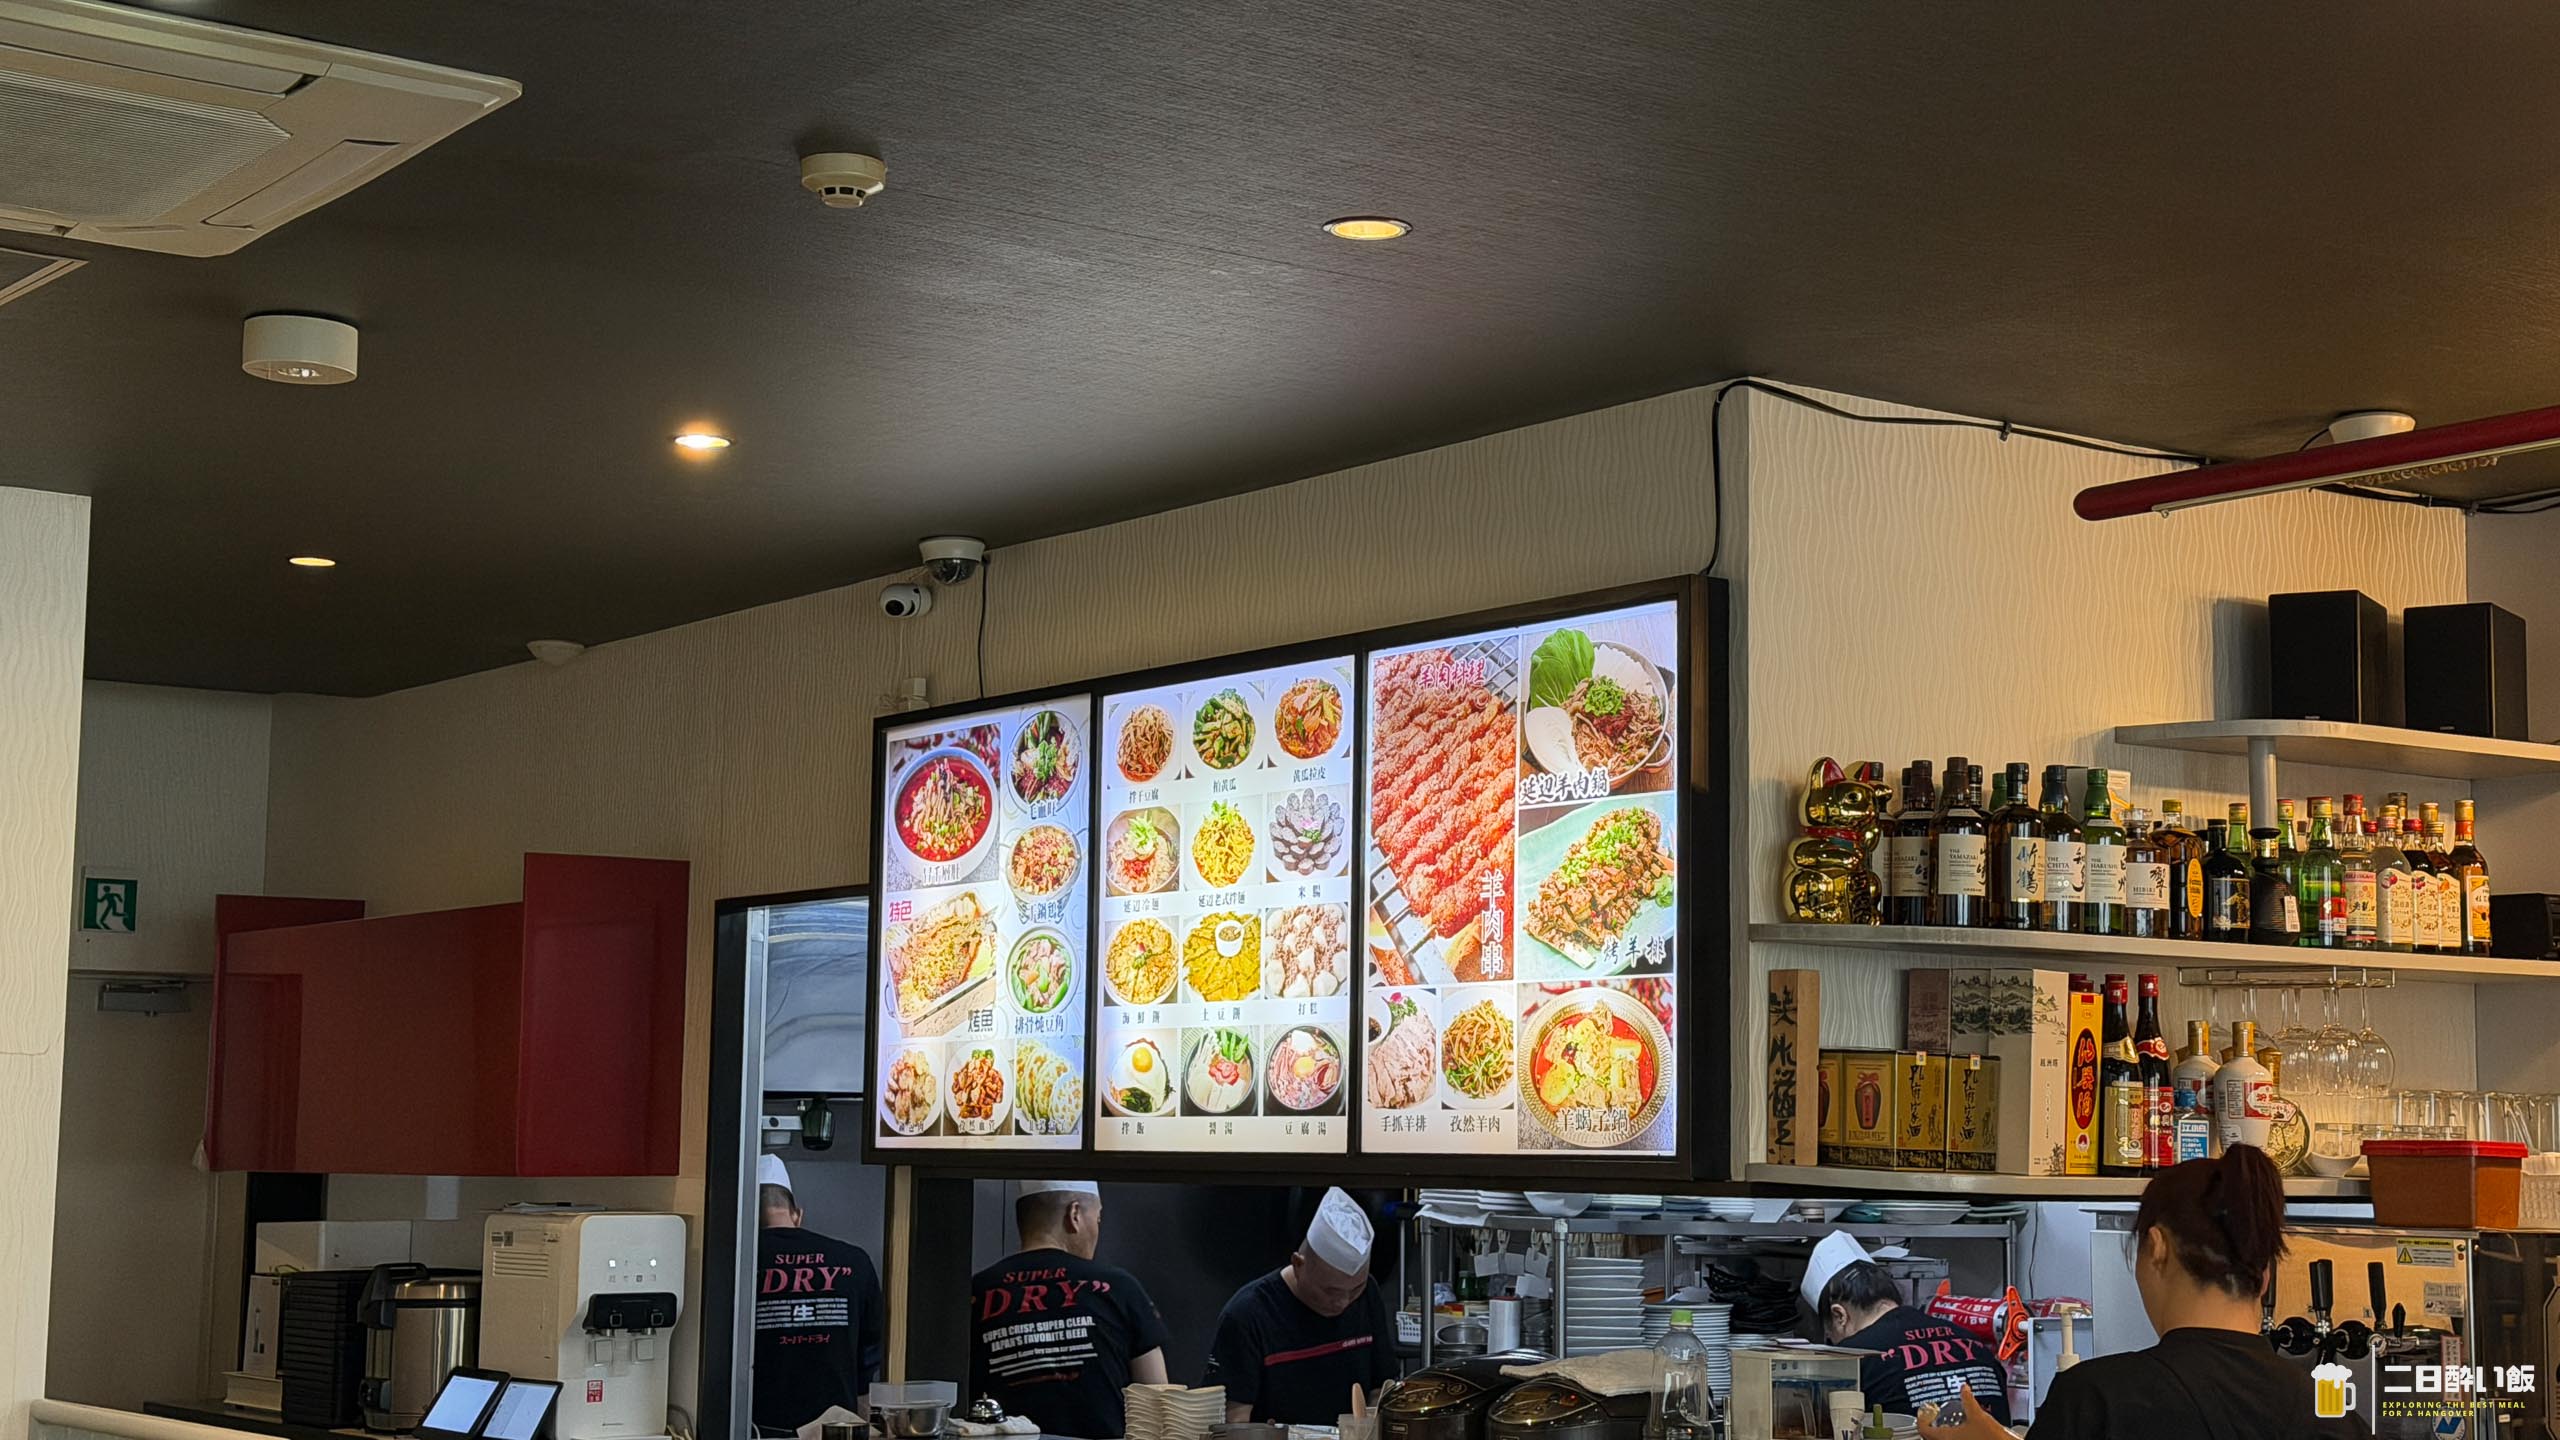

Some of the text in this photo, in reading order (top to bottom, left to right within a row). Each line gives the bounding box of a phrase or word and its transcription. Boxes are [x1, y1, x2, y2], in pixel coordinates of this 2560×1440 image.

[888, 900, 912, 922] 特色
[1480, 869, 1505, 979] 羊肉串
[1602, 935, 1667, 967] 烤羊排
[1380, 1114, 1428, 1132] 手抓羊排
[1450, 1114, 1501, 1132] 孜然羊肉
[775, 1253, 825, 1265] SUPER
[1003, 1267, 1067, 1284] SUPER
[793, 1304, 816, 1321] 生
[982, 1327, 1008, 1344] SUPER
[1036, 1319, 1065, 1332] SUPER
[1023, 1330, 1065, 1345] FAVORITE
[1066, 1327, 1088, 1340] BEER
[1904, 1326, 1955, 1340] SUPER
